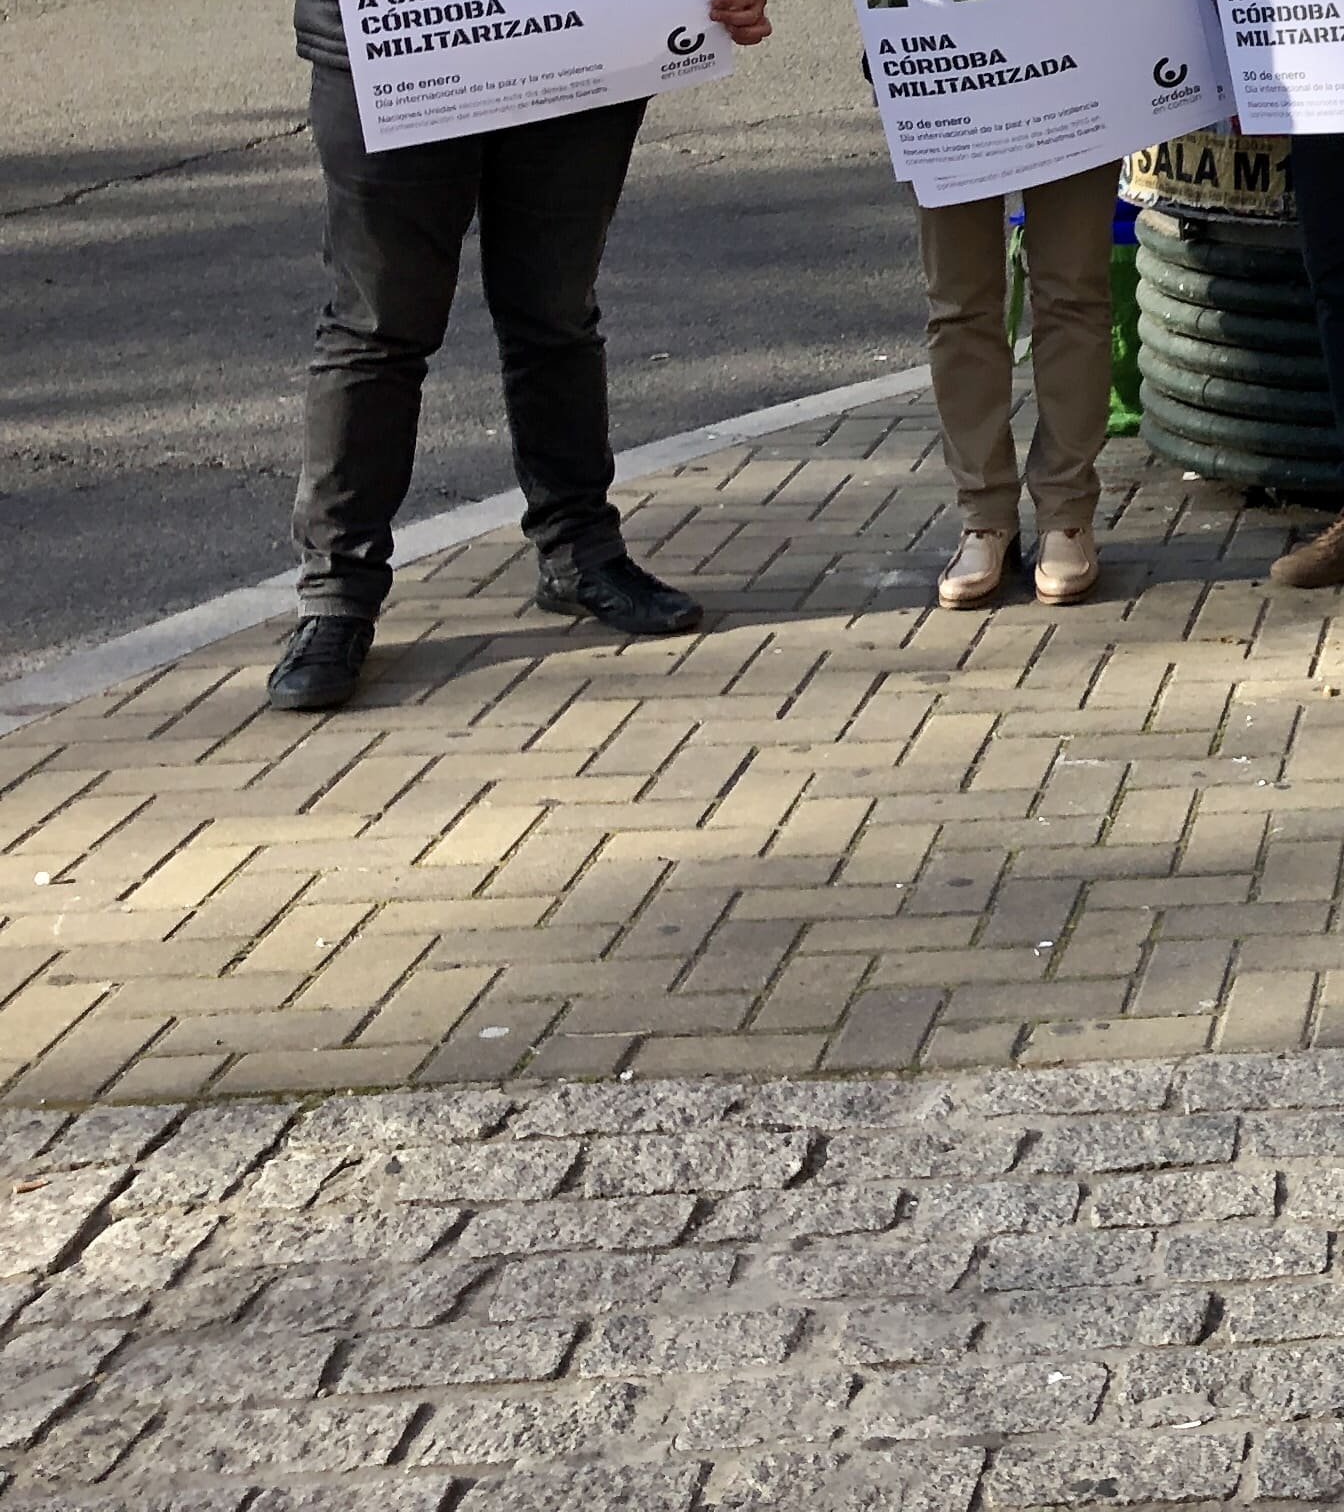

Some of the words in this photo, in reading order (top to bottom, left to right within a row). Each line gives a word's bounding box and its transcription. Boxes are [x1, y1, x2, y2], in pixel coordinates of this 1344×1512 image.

[1231, 2, 1340, 24] CÓRDOBA
[366, 10, 584, 60] MILITARIZADA
[879, 38, 896, 55] A
[901, 34, 956, 53] UNA
[883, 48, 1007, 77] CÓRDOBA
[888, 54, 1078, 99] MILITARIZADA
[1137, 142, 1219, 188] SALA
